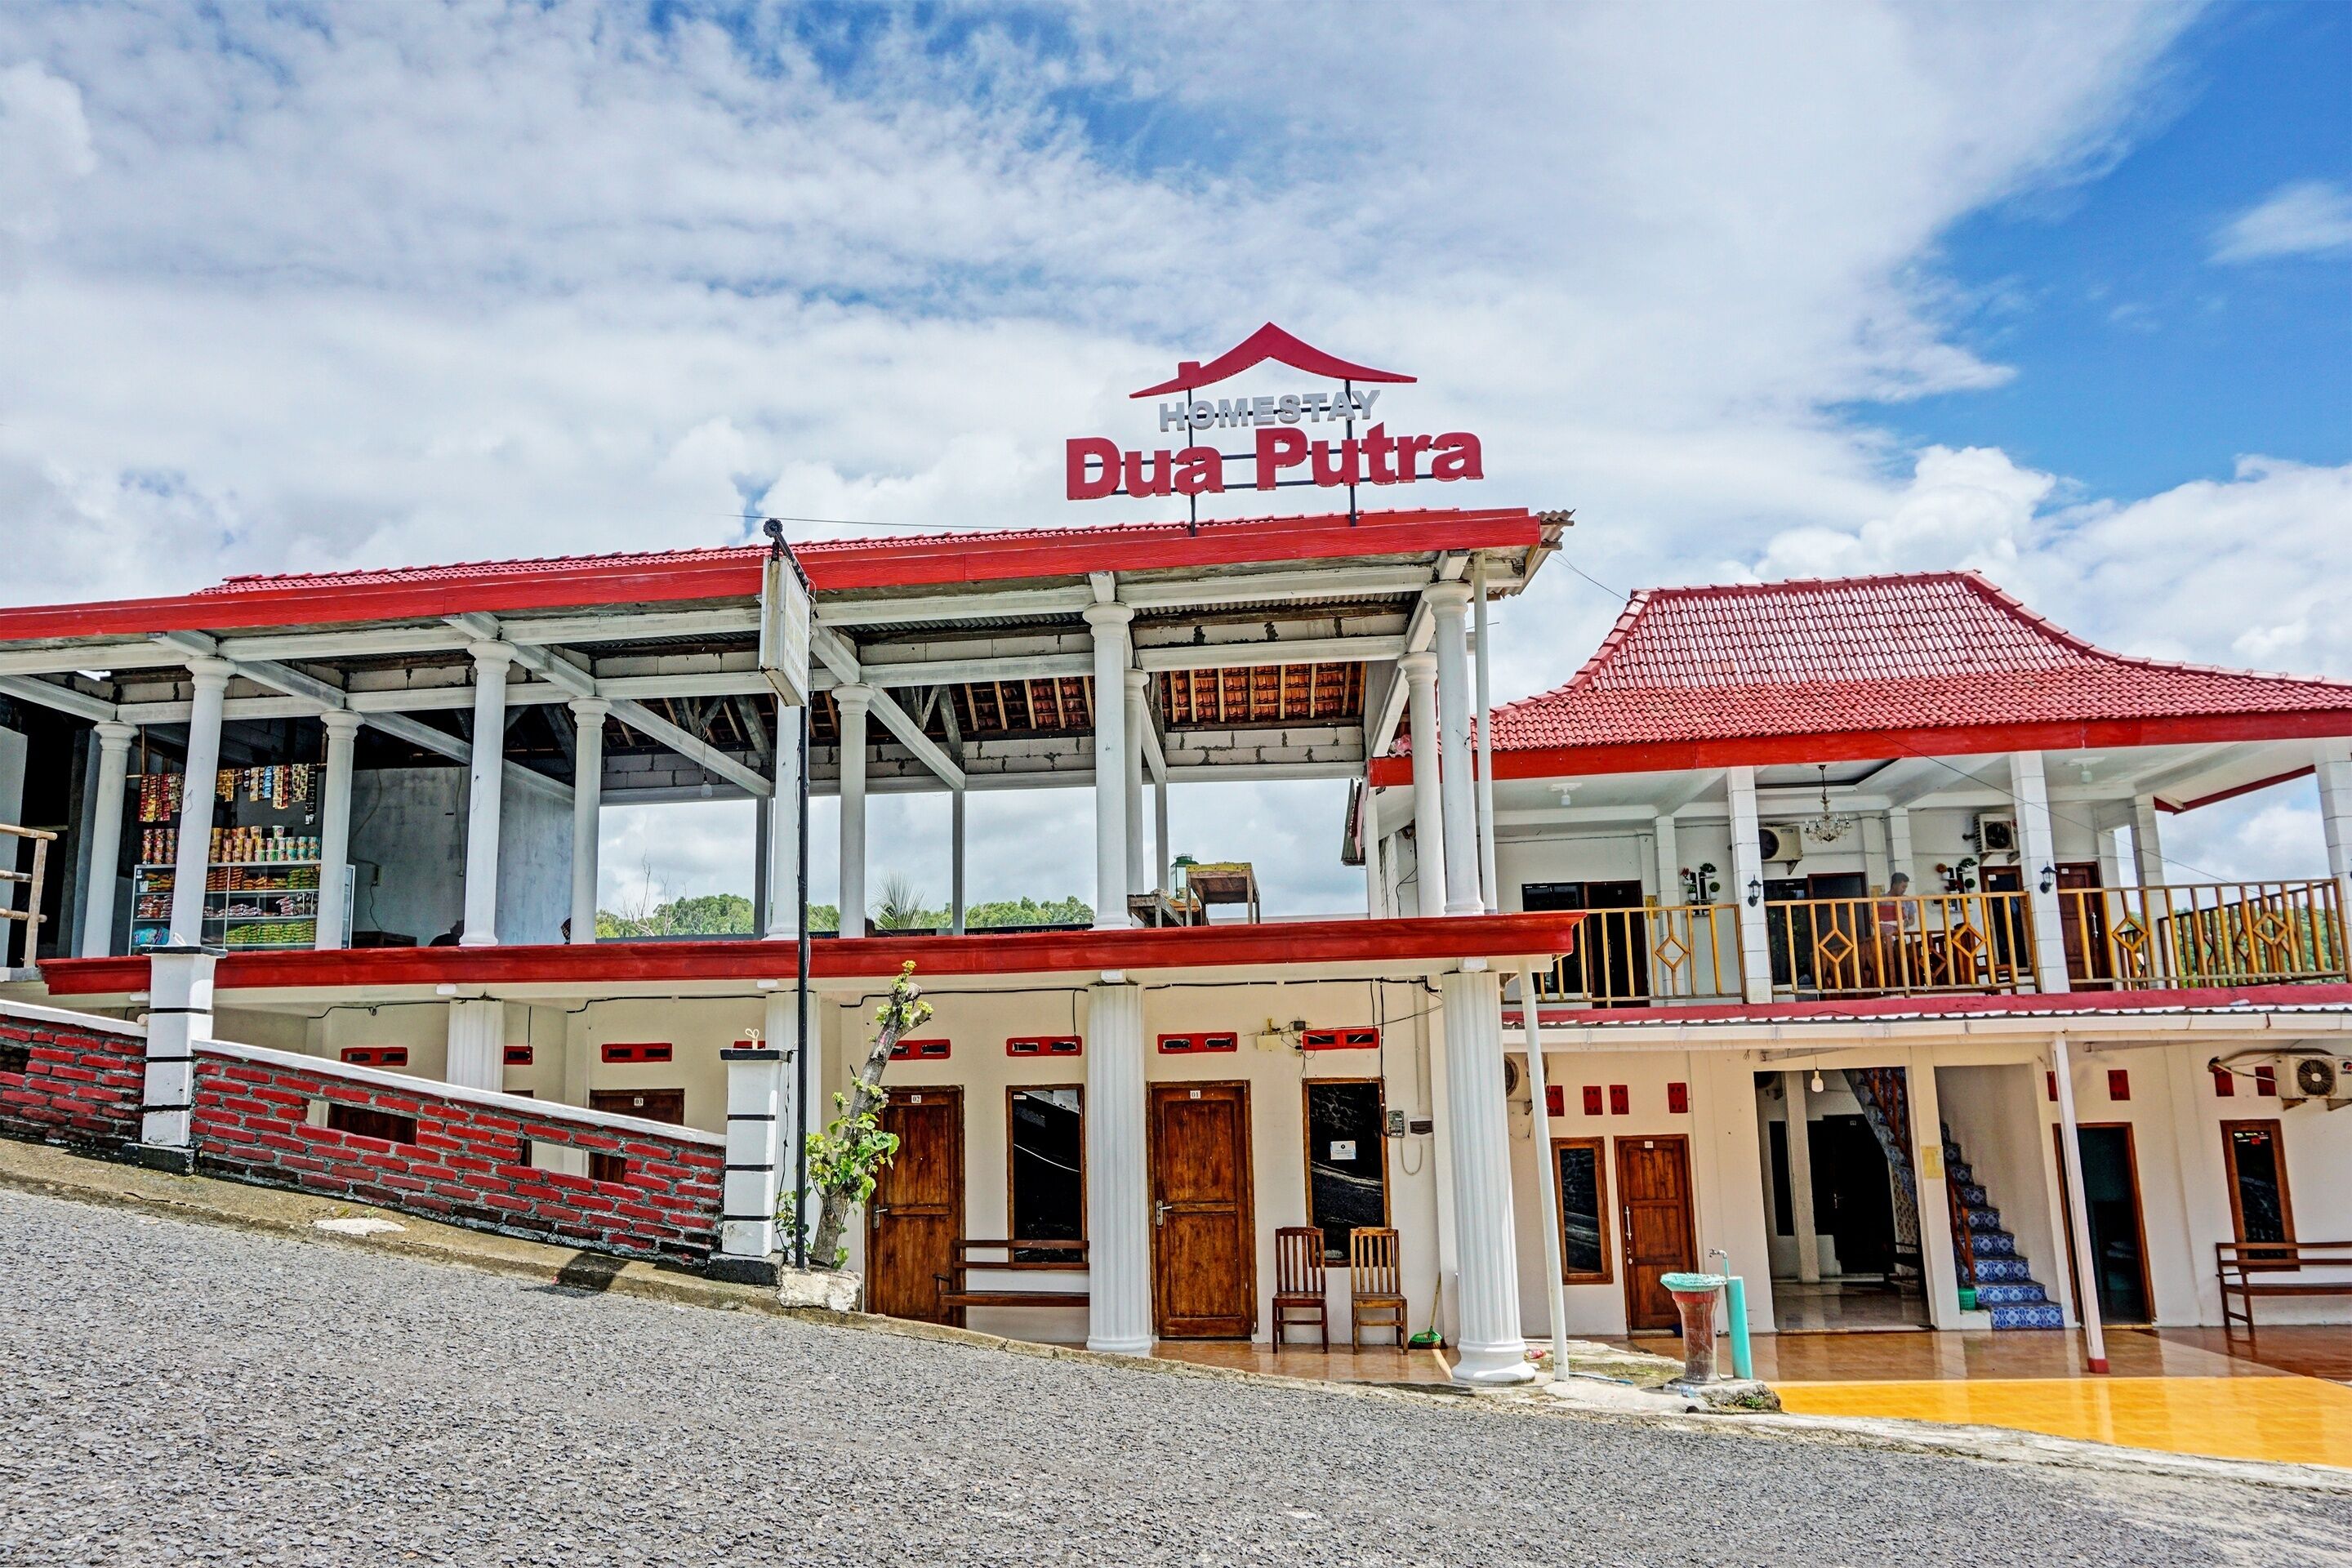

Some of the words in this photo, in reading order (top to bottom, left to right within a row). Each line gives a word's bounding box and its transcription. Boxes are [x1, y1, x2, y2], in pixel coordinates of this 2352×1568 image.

[1160, 390, 1380, 432] HOMESTAY
[1067, 437, 1225, 500] Dua
[1255, 421, 1484, 491] Putra
